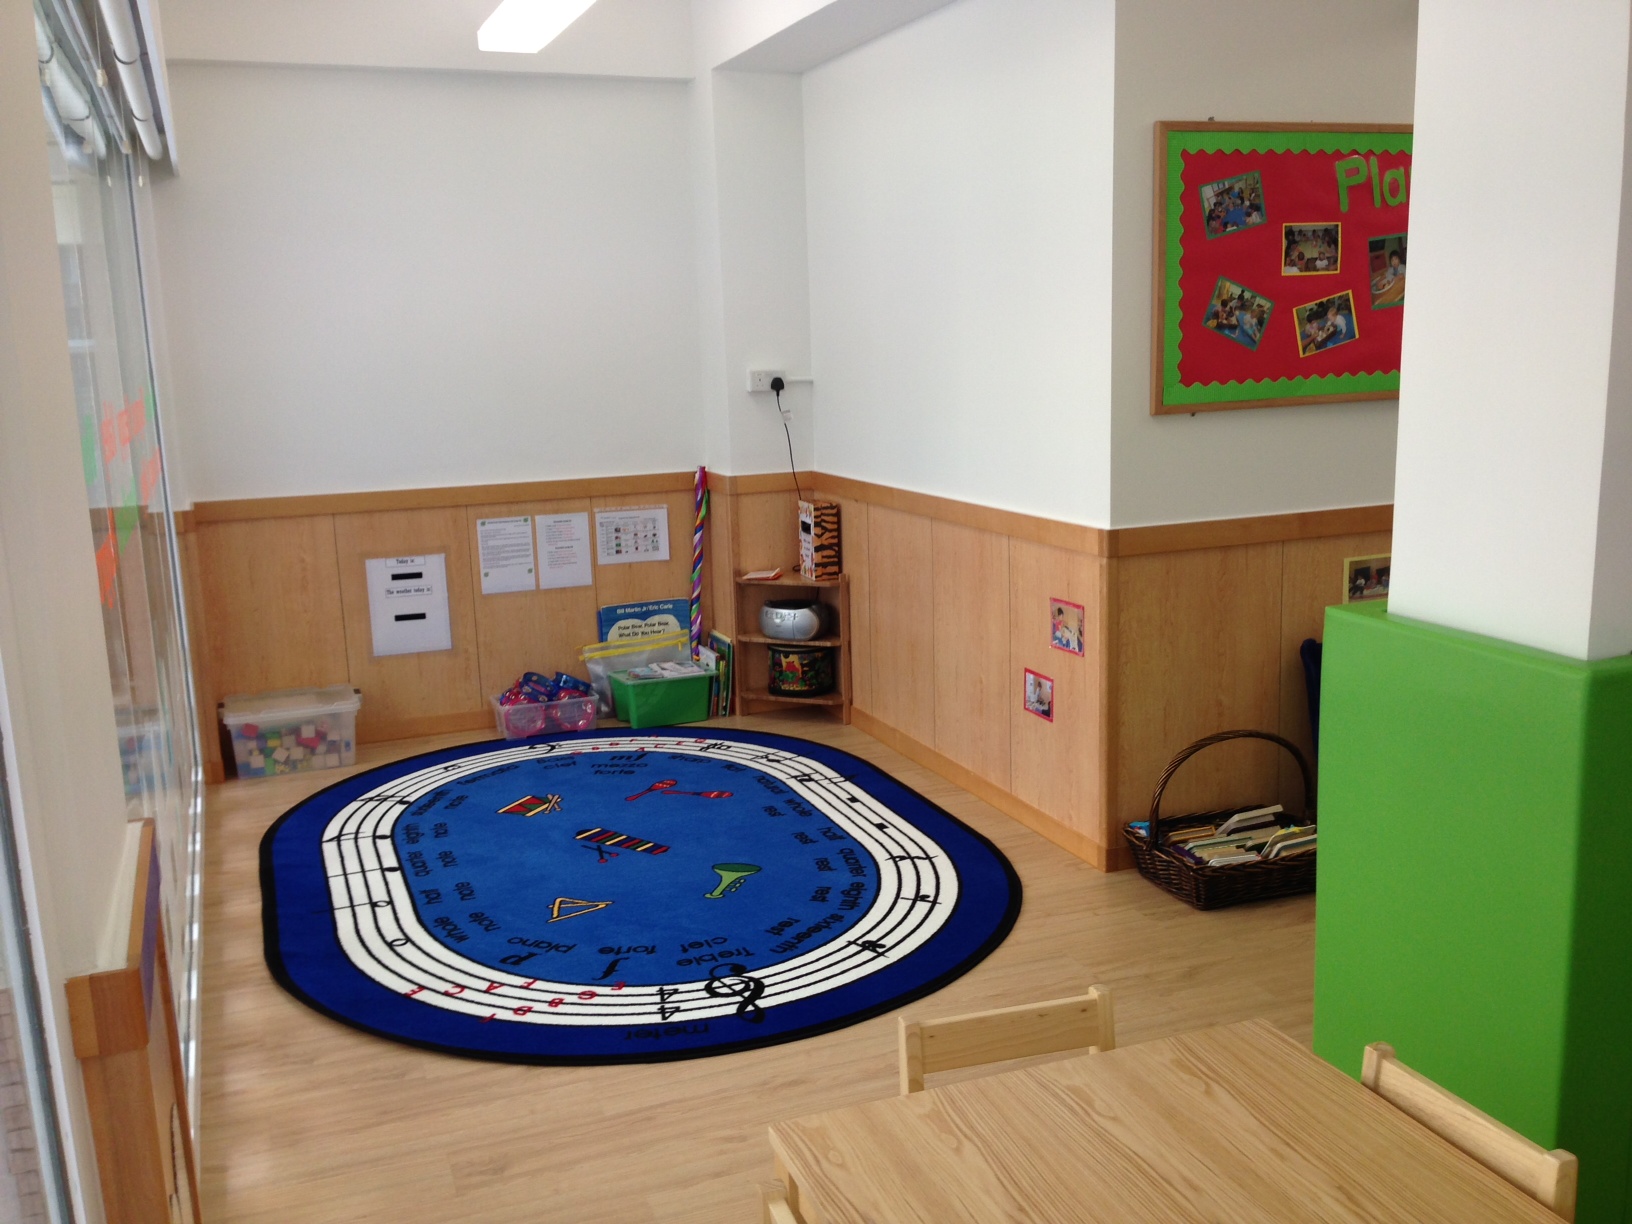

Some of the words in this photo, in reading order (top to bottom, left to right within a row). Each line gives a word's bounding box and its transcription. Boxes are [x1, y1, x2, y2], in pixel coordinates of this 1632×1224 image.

[1335, 155, 1412, 213] Pla
[436, 851, 458, 868] note
[814, 857, 837, 872] rest
[837, 848, 867, 877] quarter
[453, 882, 476, 901] note
[838, 881, 867, 910] eighth
[433, 916, 470, 943] whole
[468, 912, 502, 932] note
[765, 917, 801, 936] rest
[507, 936, 577, 954] piano
[598, 945, 657, 955] forte
[680, 936, 728, 953] clef
[676, 947, 754, 966] Treble
